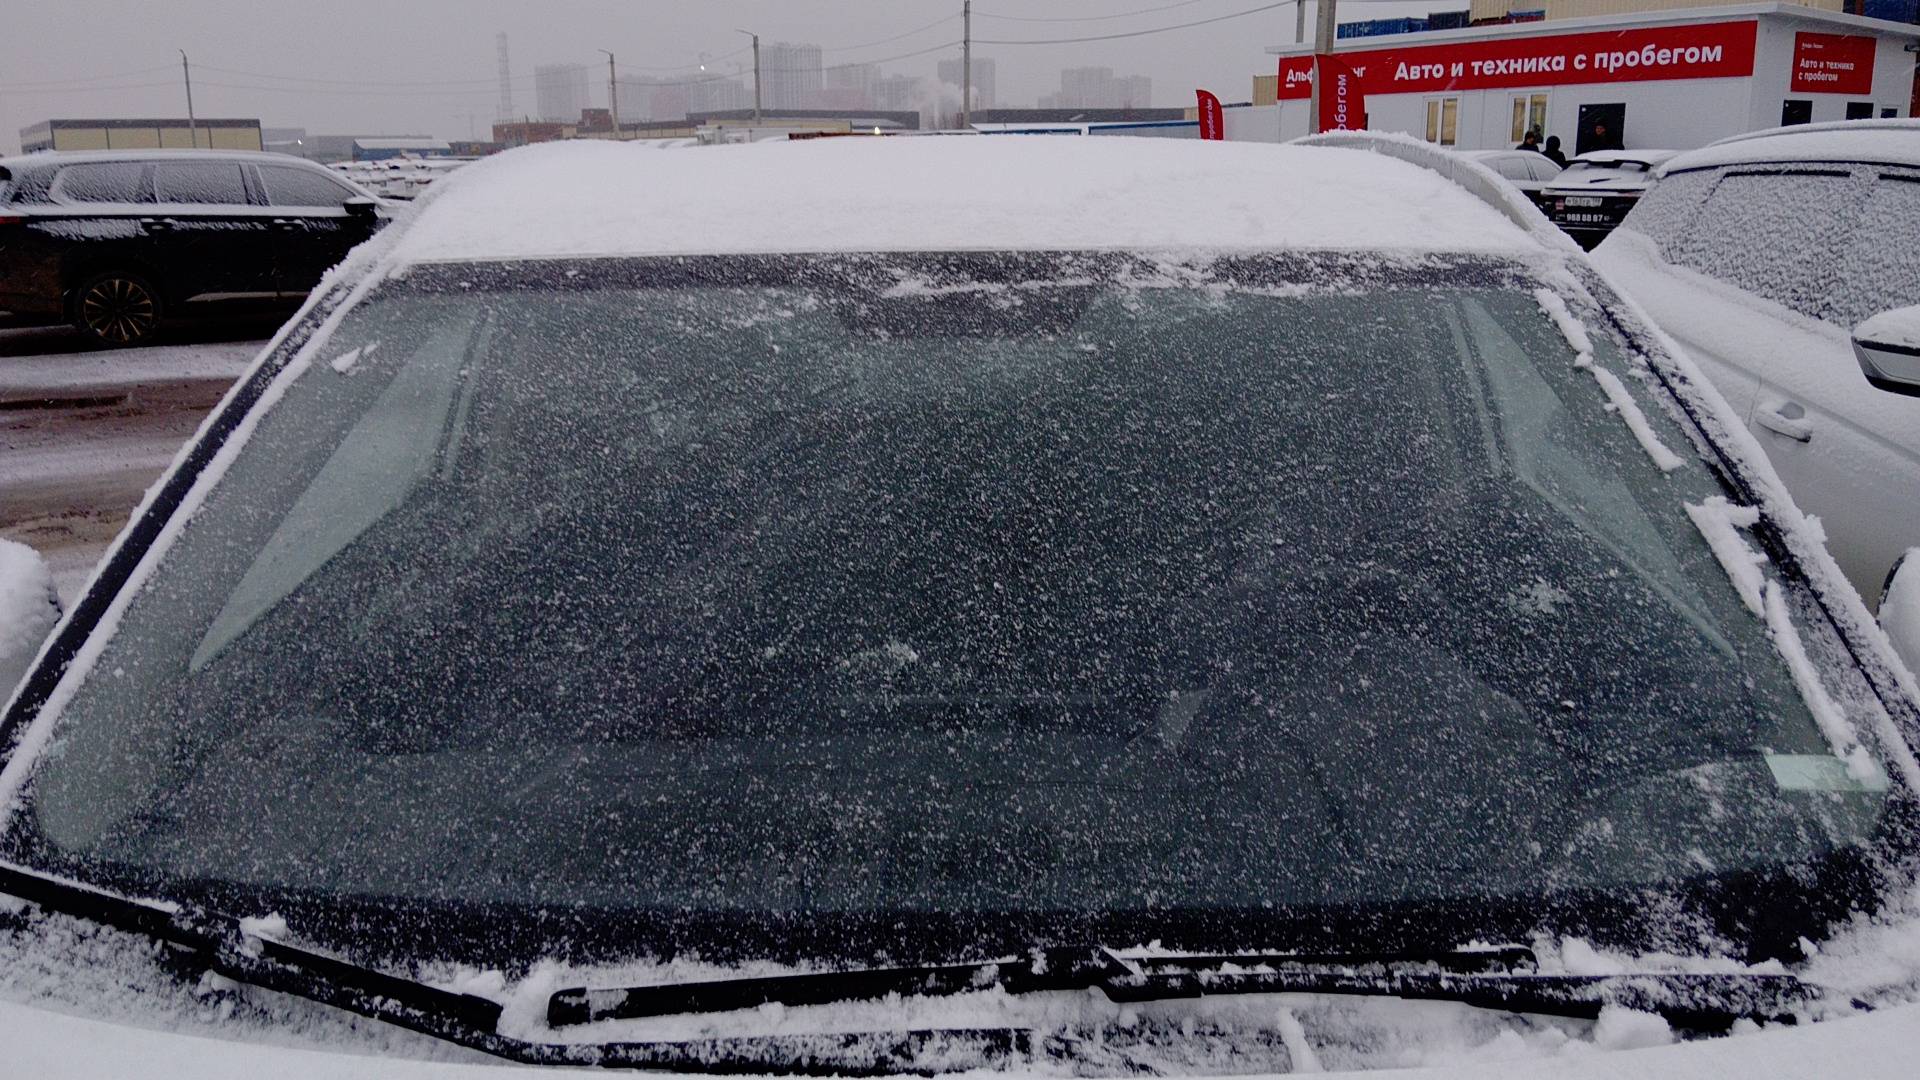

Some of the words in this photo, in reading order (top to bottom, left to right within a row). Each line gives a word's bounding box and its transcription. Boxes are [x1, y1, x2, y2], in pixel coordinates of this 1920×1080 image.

[1394, 62, 1444, 81] Авто
[1451, 62, 1463, 77] и
[1471, 55, 1566, 76] техника
[1574, 54, 1587, 70] с
[1594, 44, 1722, 73] пробегом
[1800, 58, 1818, 69] Авто
[1819, 61, 1825, 69] и
[1826, 61, 1854, 70] техника
[1286, 68, 1314, 84] Альф
[1798, 72, 1803, 80] с
[1804, 71, 1838, 82] пробегом
[1334, 74, 1347, 130] обегом
